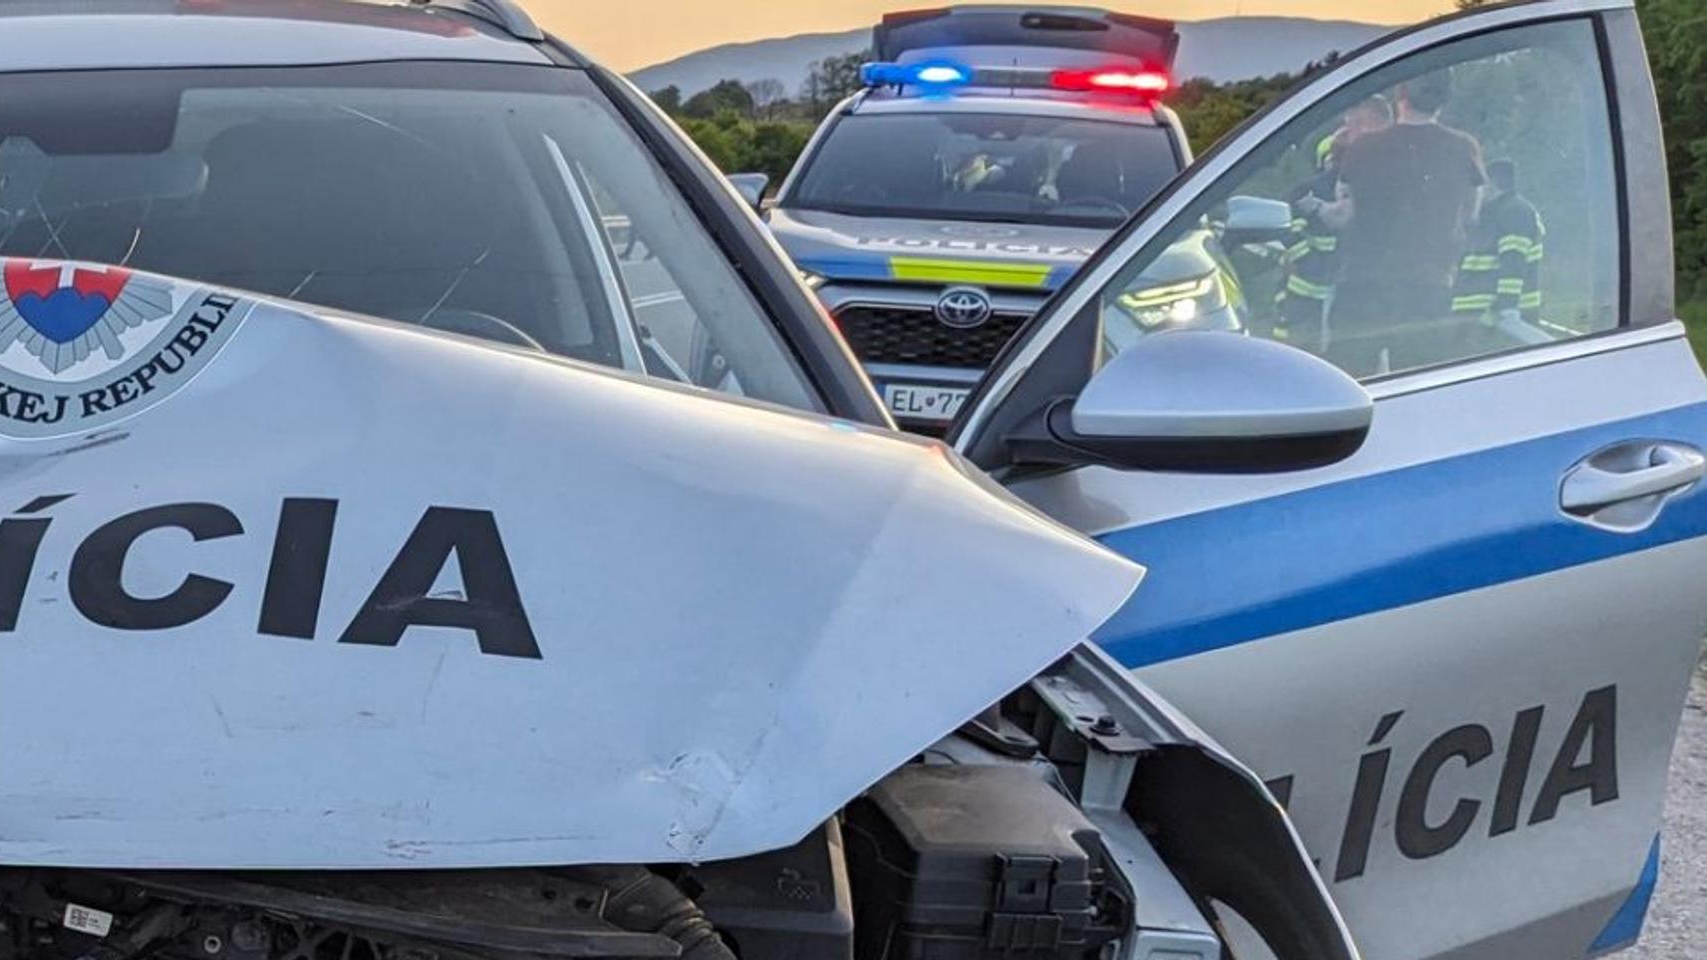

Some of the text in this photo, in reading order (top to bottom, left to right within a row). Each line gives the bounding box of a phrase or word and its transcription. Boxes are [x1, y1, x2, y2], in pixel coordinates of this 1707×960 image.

[80, 292, 240, 419] REPUBLI
[892, 389, 923, 412] EL
[1264, 683, 1620, 883] ÍCIA
